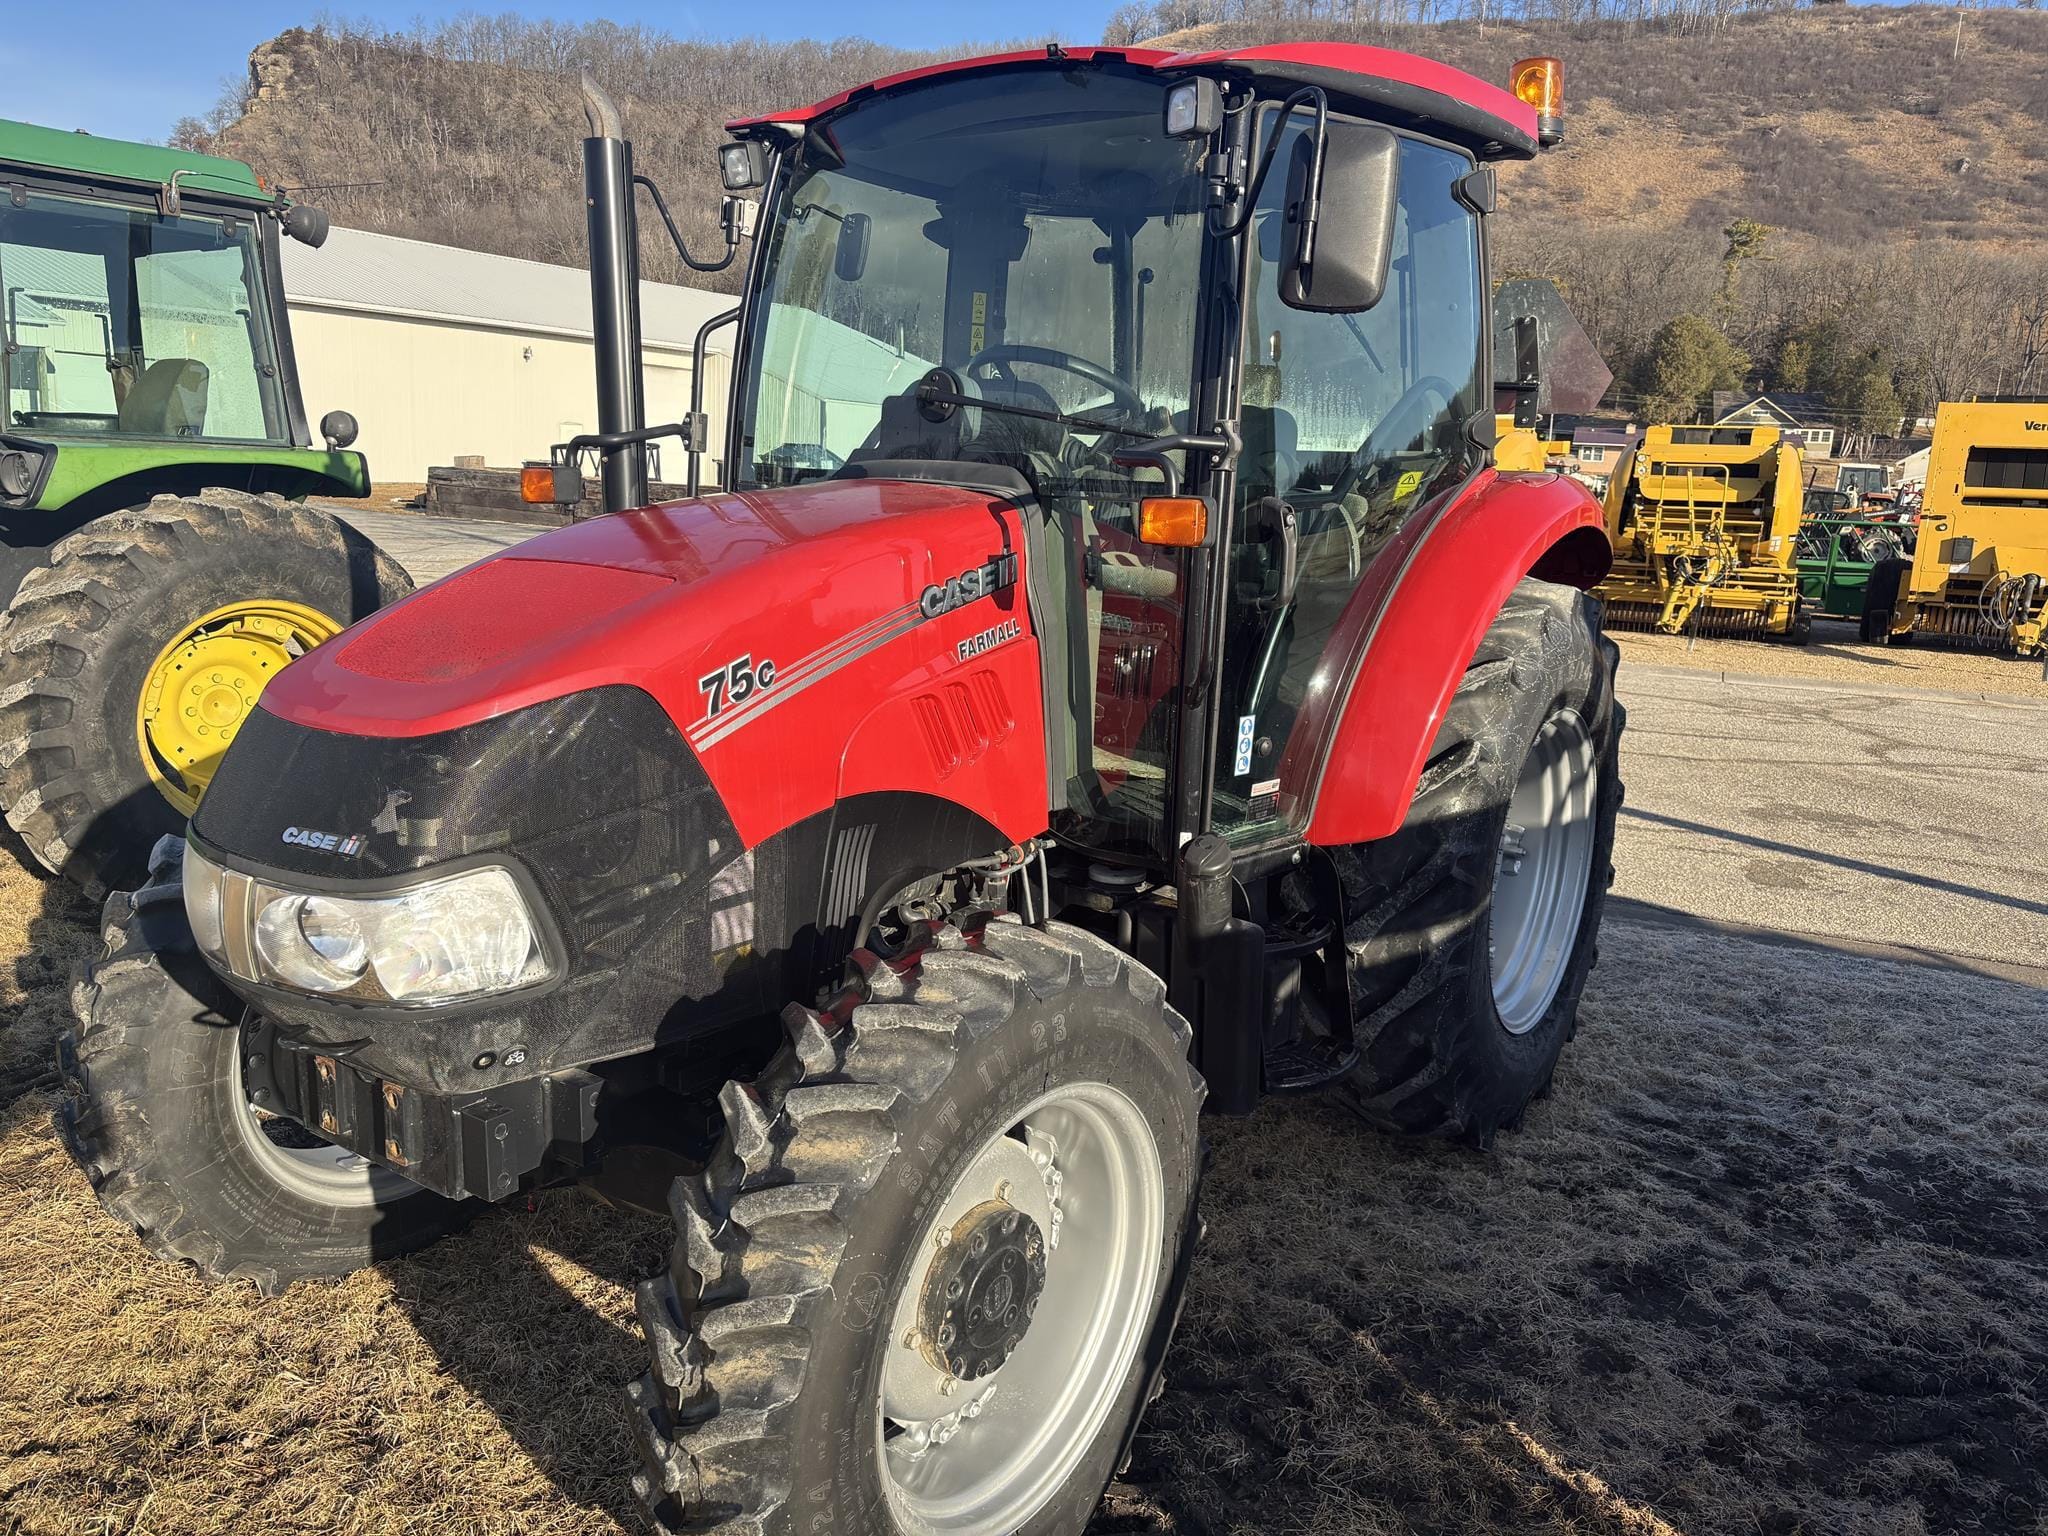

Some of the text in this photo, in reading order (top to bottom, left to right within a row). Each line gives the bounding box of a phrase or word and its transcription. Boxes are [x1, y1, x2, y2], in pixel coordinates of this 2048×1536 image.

[2025, 420, 2048, 431] Ver
[920, 562, 996, 620] CASE
[957, 617, 1021, 663] FARMALL
[282, 826, 338, 852] CASE
